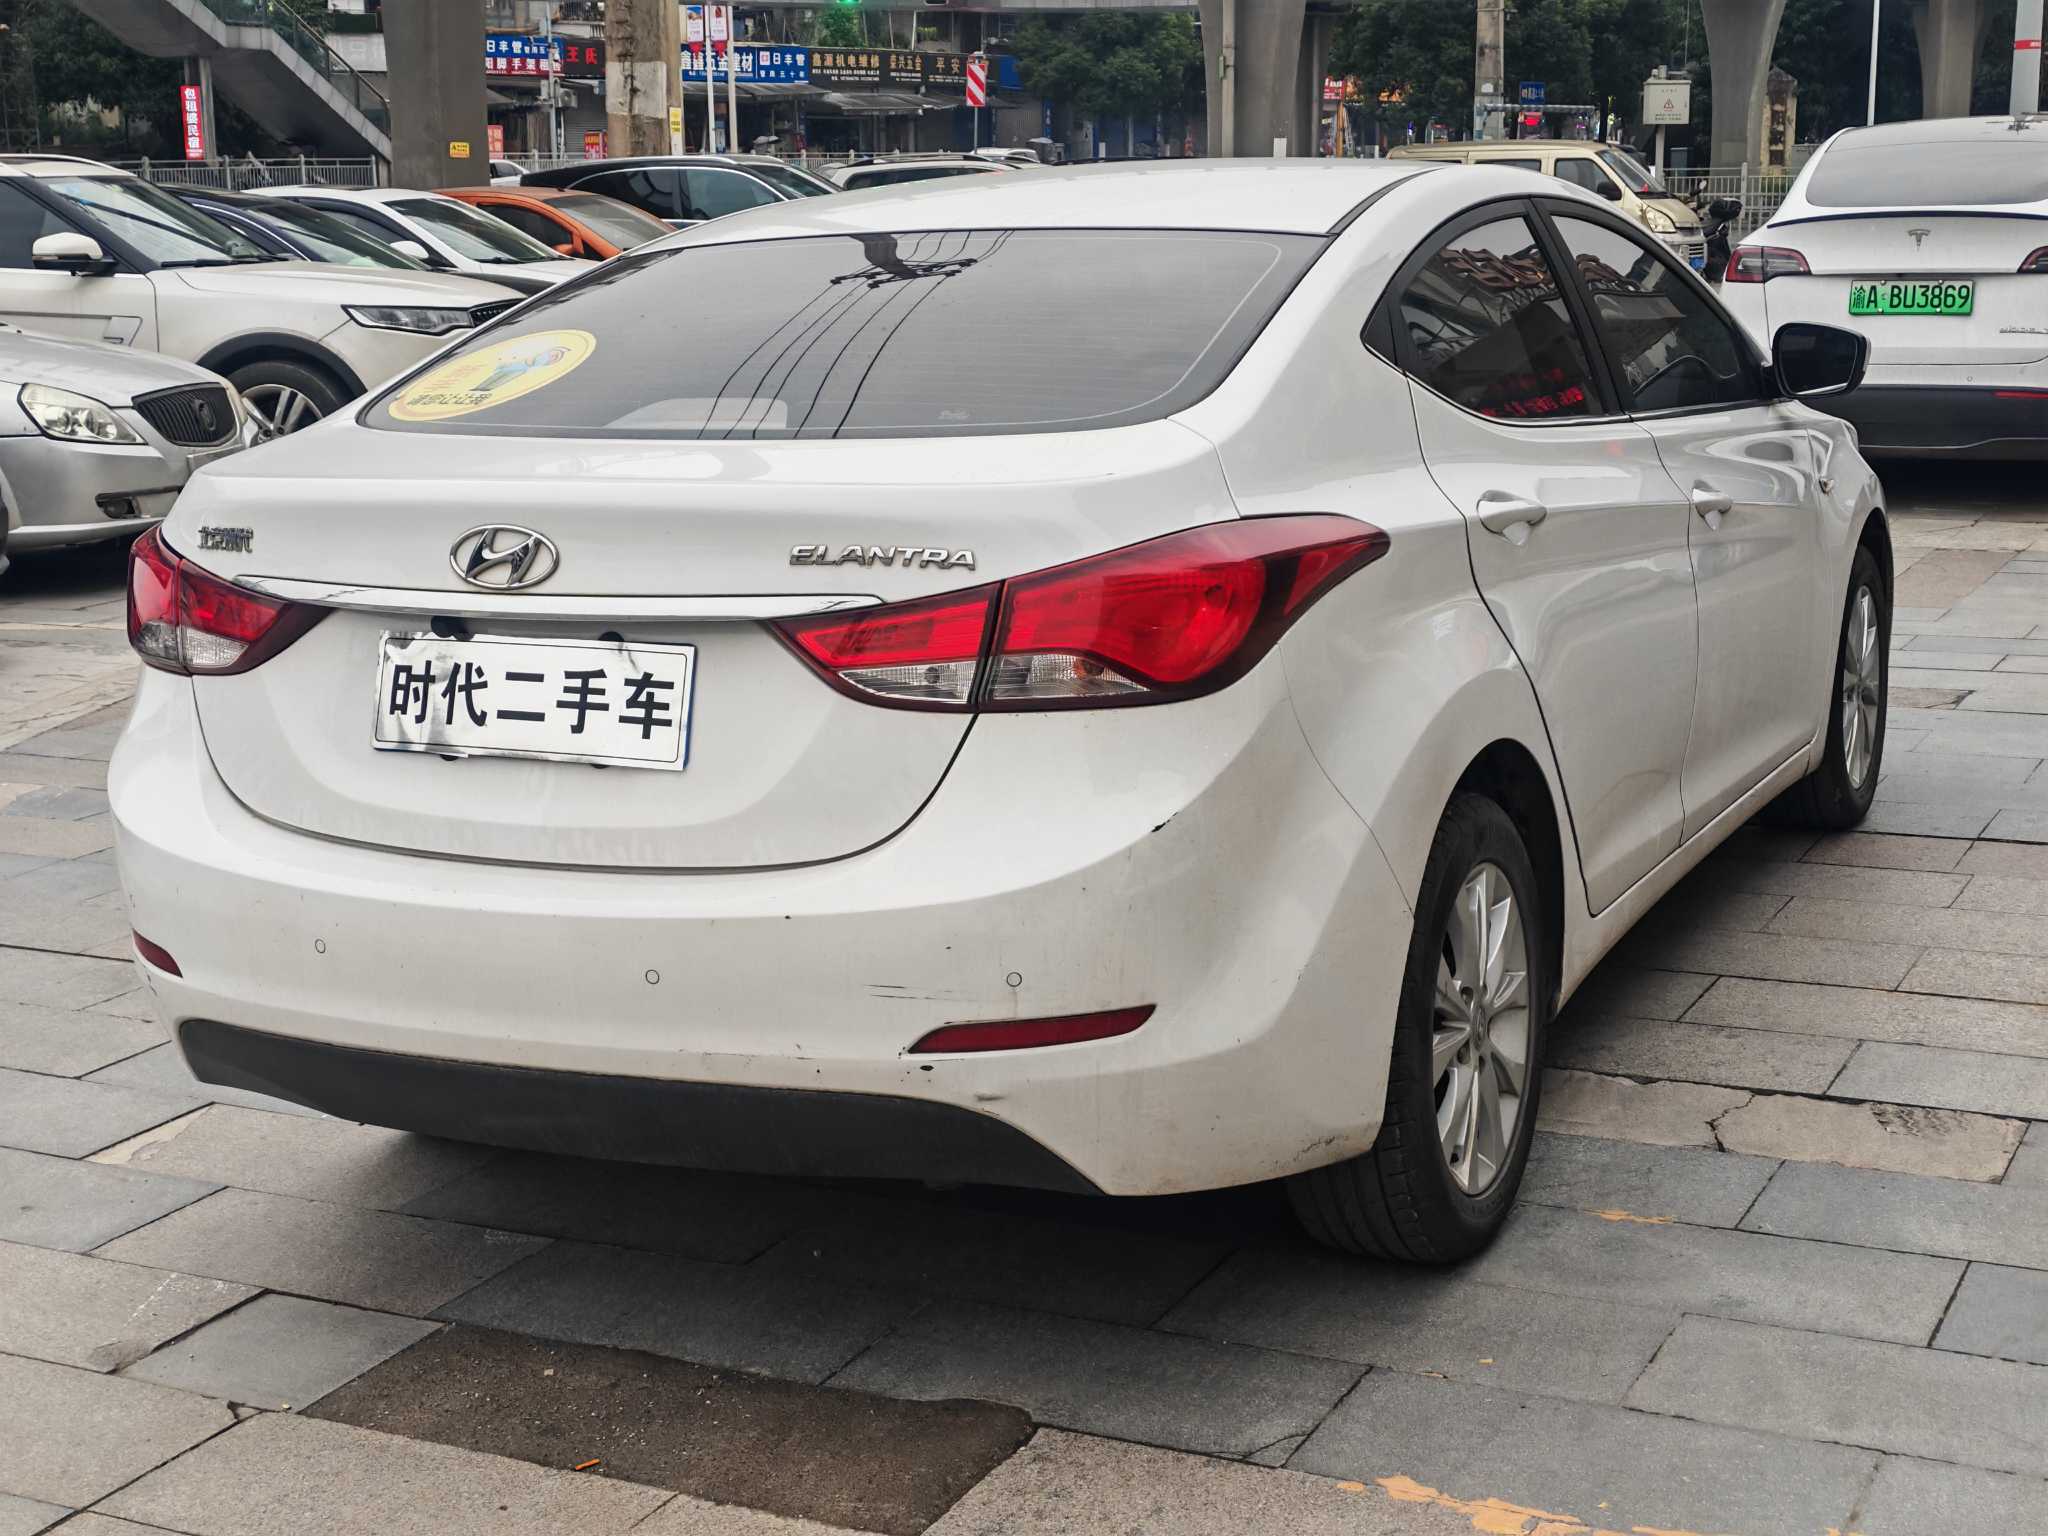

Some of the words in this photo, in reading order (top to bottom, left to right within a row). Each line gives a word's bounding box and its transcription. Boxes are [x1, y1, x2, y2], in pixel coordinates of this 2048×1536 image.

[788, 543, 977, 571] ELANTRA
[389, 660, 676, 742] 时代二手车
